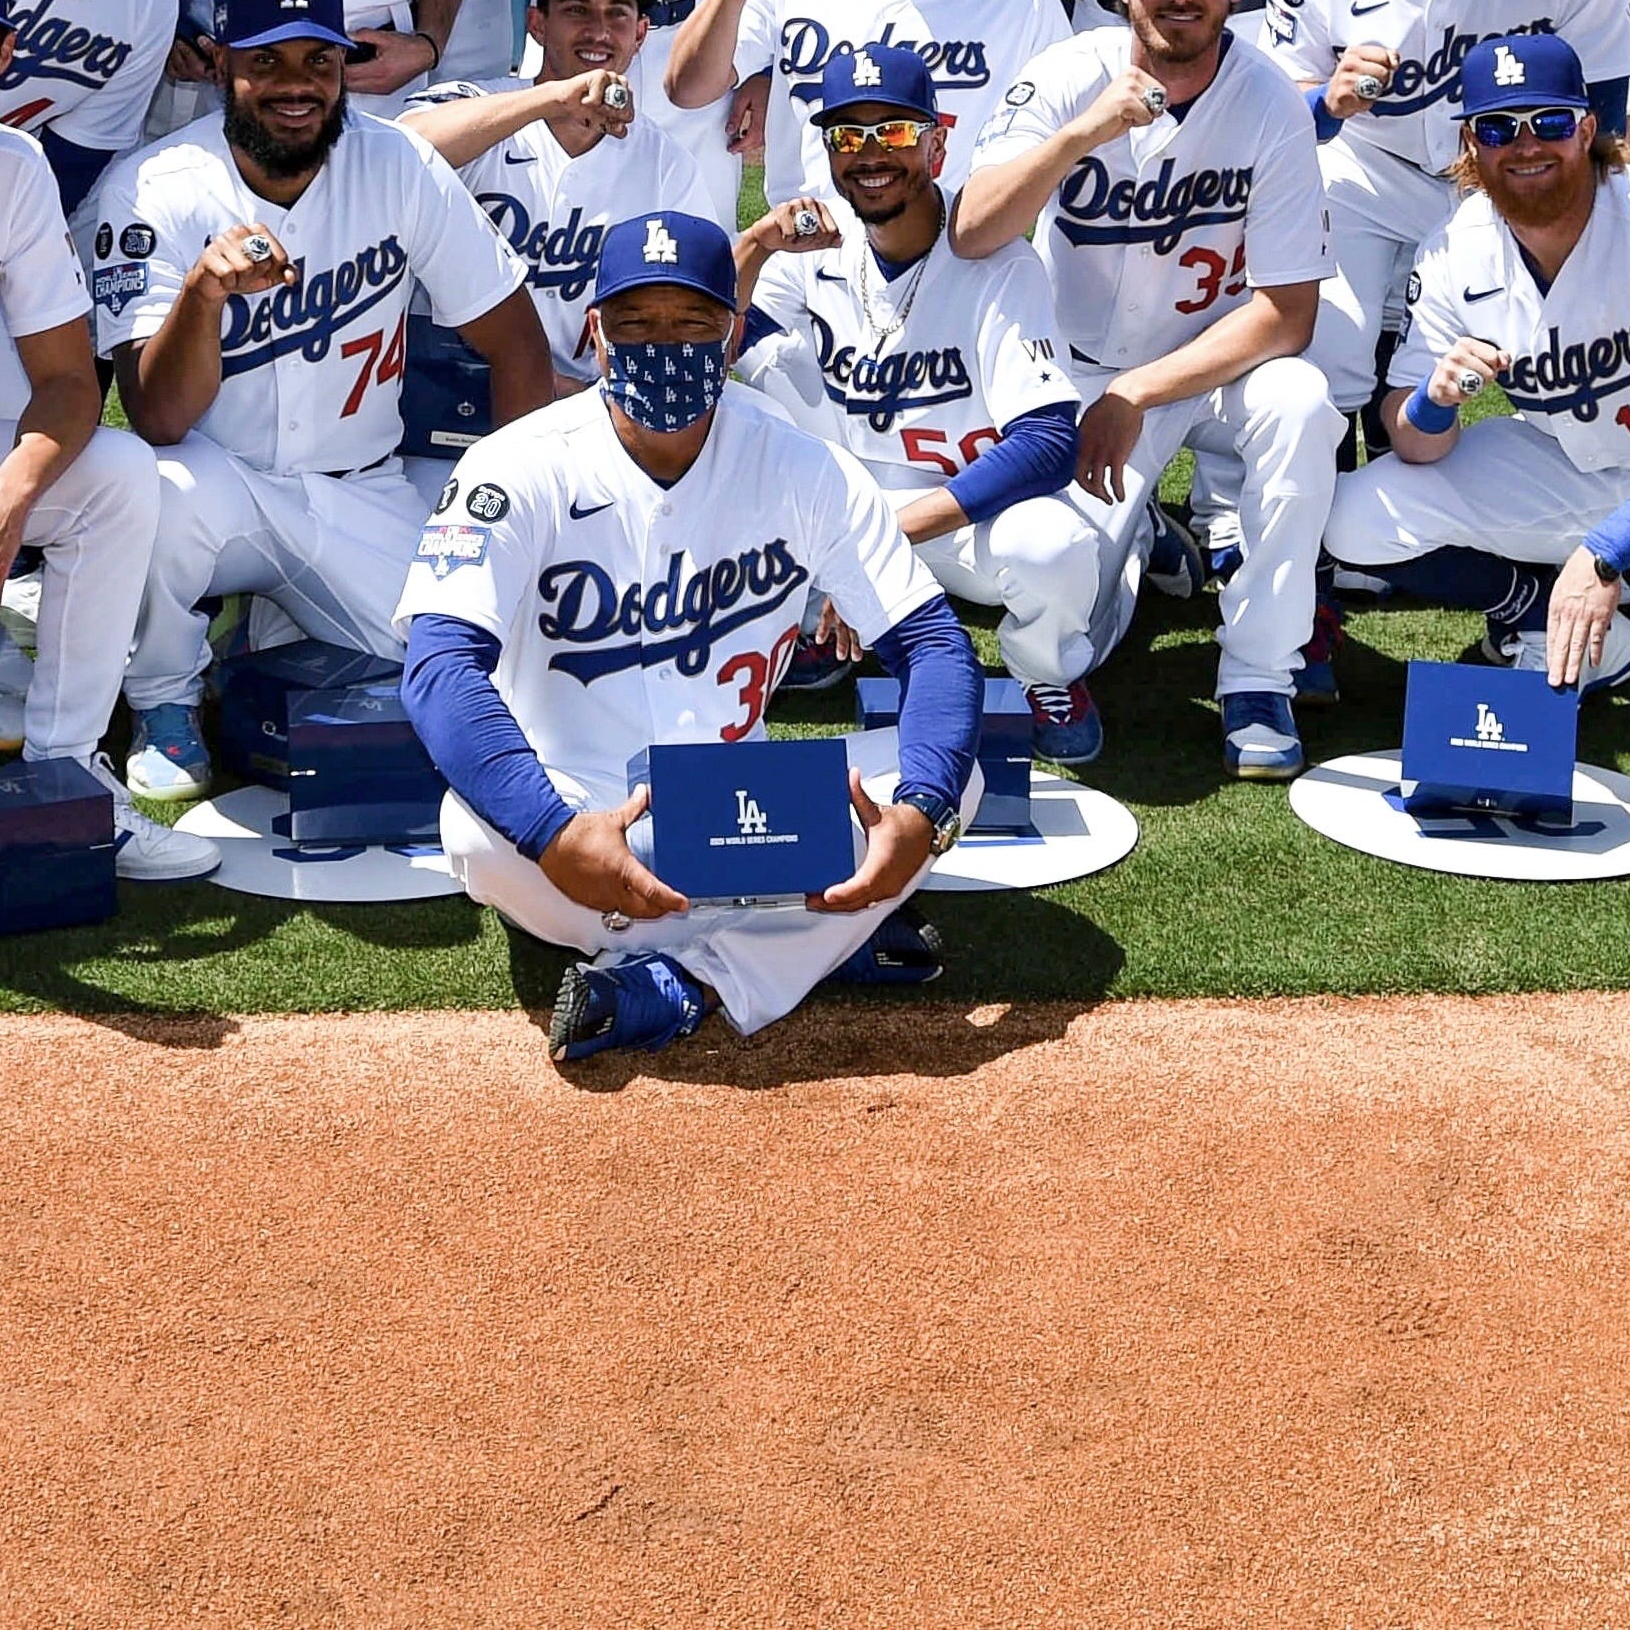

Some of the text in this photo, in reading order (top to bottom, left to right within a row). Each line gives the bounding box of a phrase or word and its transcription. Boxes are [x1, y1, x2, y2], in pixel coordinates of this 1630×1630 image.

[853, 45, 880, 86] LA
[1494, 46, 1524, 85] LA
[1056, 156, 1254, 256] Dodgers
[643, 219, 676, 262] LA
[342, 314, 405, 418] 74
[1023, 339, 1054, 362] VII
[899, 427, 1002, 477] 50
[470, 492, 502, 518] 20
[538, 539, 808, 680] Dodgers
[1475, 703, 1503, 741] LA
[735, 790, 767, 834] LA
